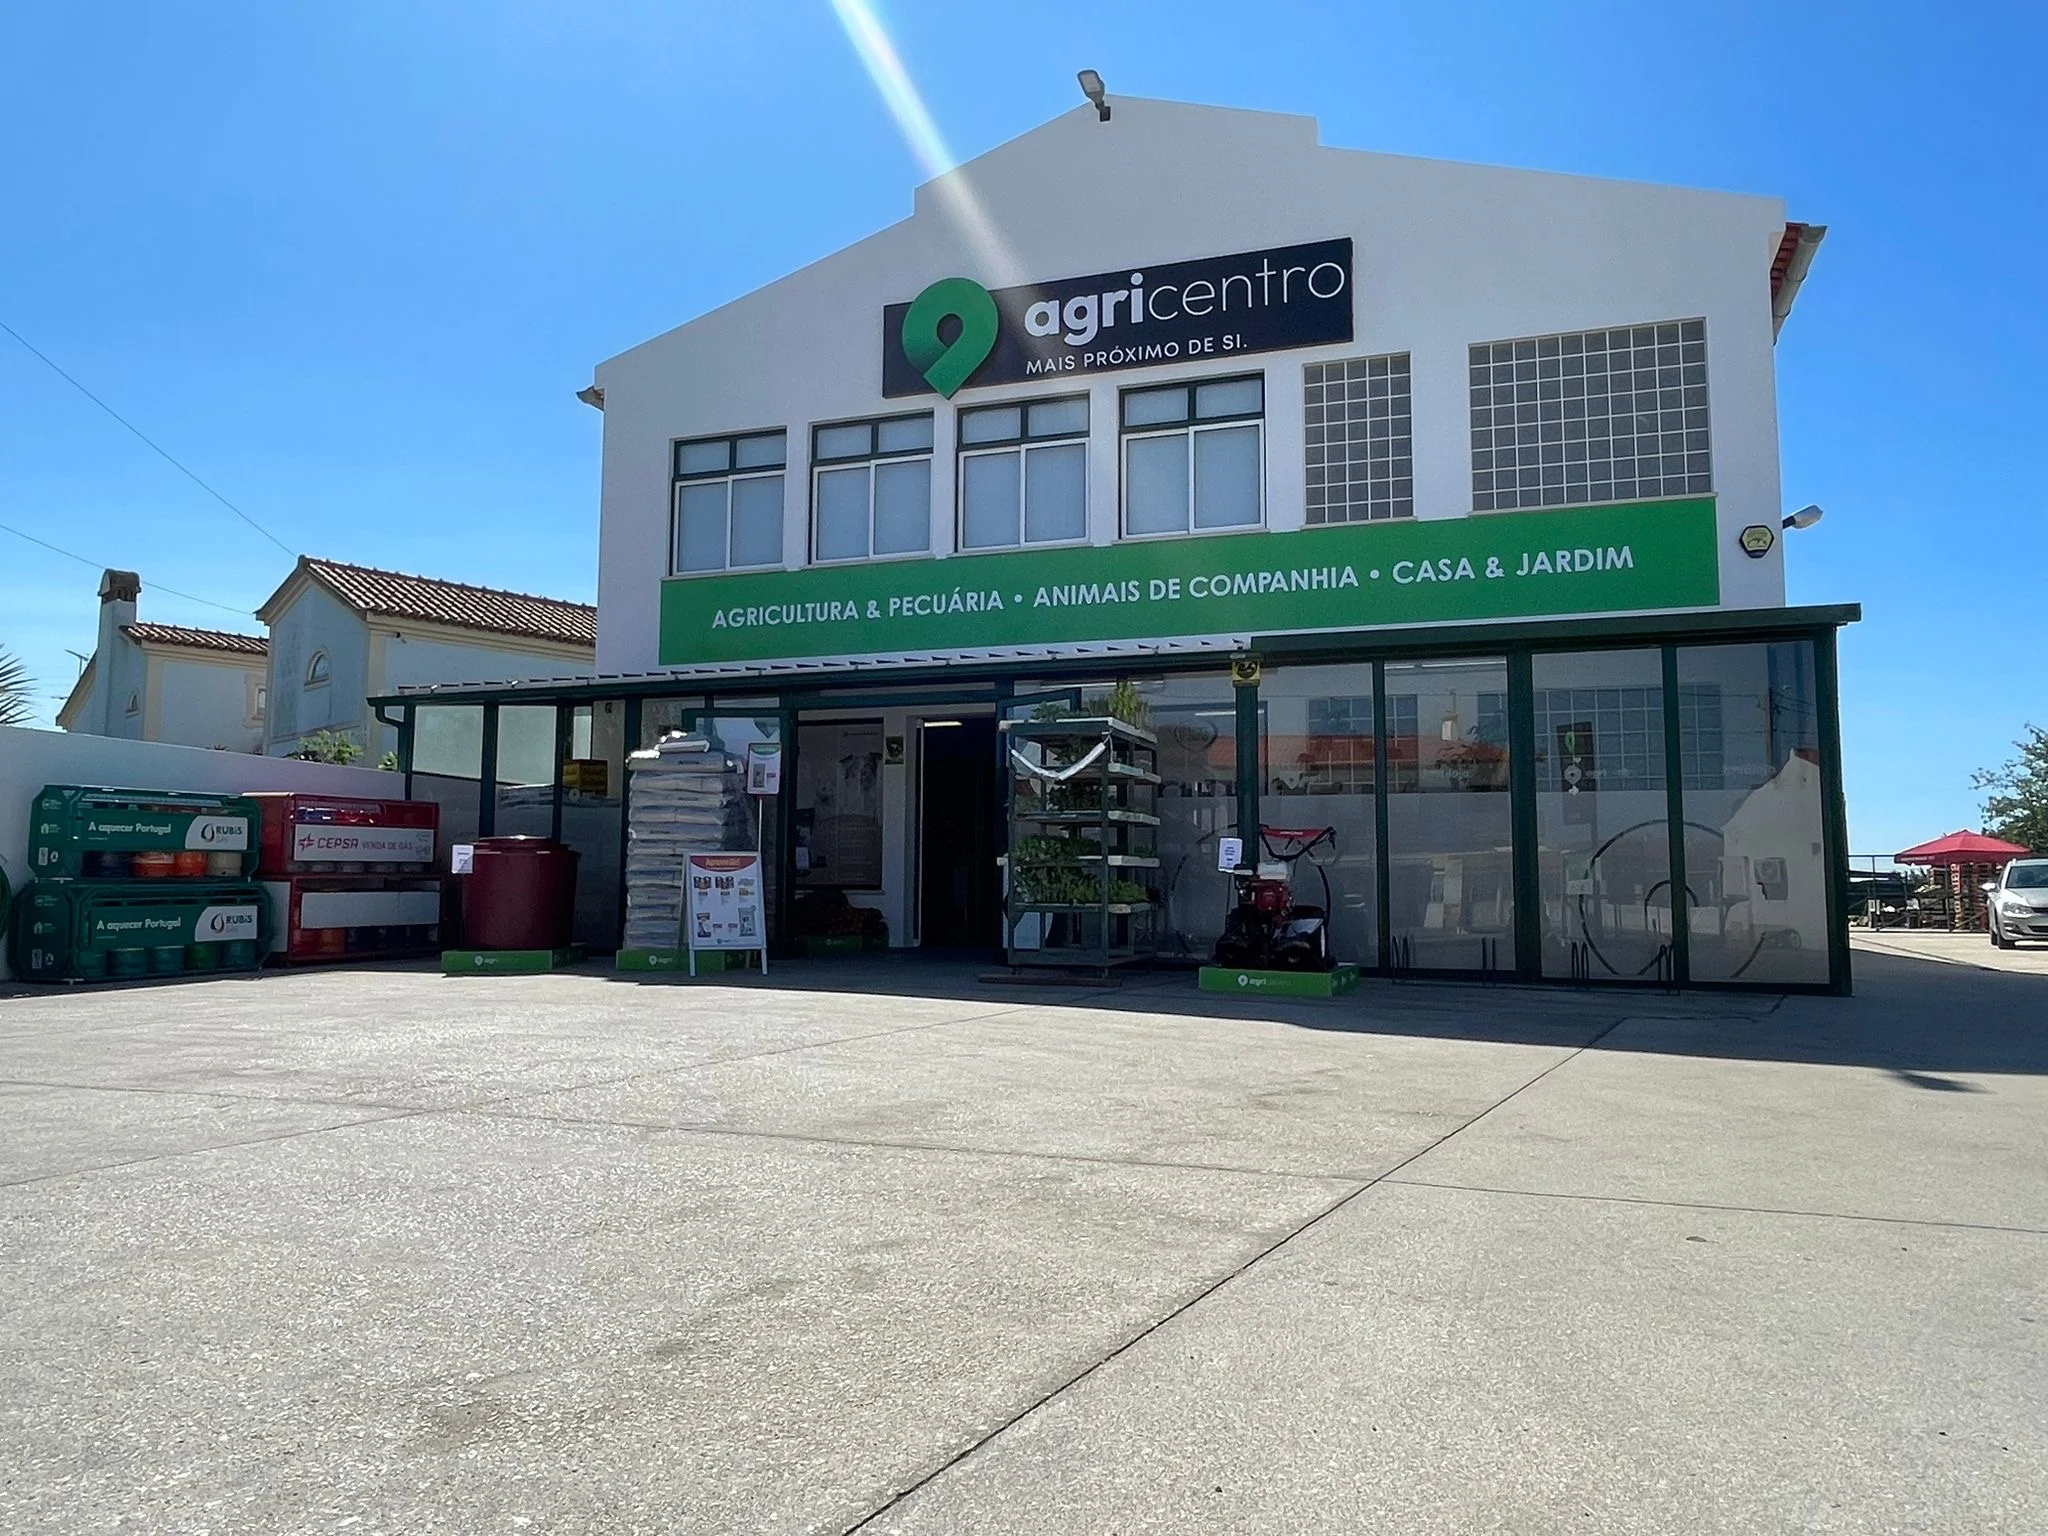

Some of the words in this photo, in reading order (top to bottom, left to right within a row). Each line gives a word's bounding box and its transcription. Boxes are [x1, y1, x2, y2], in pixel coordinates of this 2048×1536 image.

[1024, 258, 1345, 347] agricentro
[1025, 354, 1076, 375] MAIS
[1083, 341, 1180, 368] PRÓXIMO
[1188, 337, 1214, 353] DE
[1222, 334, 1248, 350] SI.
[712, 602, 859, 629] AGRICULTURA
[865, 602, 881, 619] &
[888, 587, 1004, 618] PECUÁRIA
[1033, 579, 1141, 608] ANIMAIS
[1150, 578, 1181, 600] DE
[1188, 565, 1359, 598] COMPANHIA
[1392, 557, 1476, 584] CASA
[1484, 556, 1505, 579] &
[1516, 545, 1635, 577] JARDIM
[88, 821, 96, 831] A
[98, 824, 134, 834] aquecer
[135, 822, 171, 835] Portugal
[317, 837, 359, 849] CEPSA
[362, 840, 386, 850] VENDA
[388, 841, 397, 850] DE
[96, 920, 105, 930] A
[107, 921, 143, 932] aquecer
[144, 916, 181, 930] Portugal
